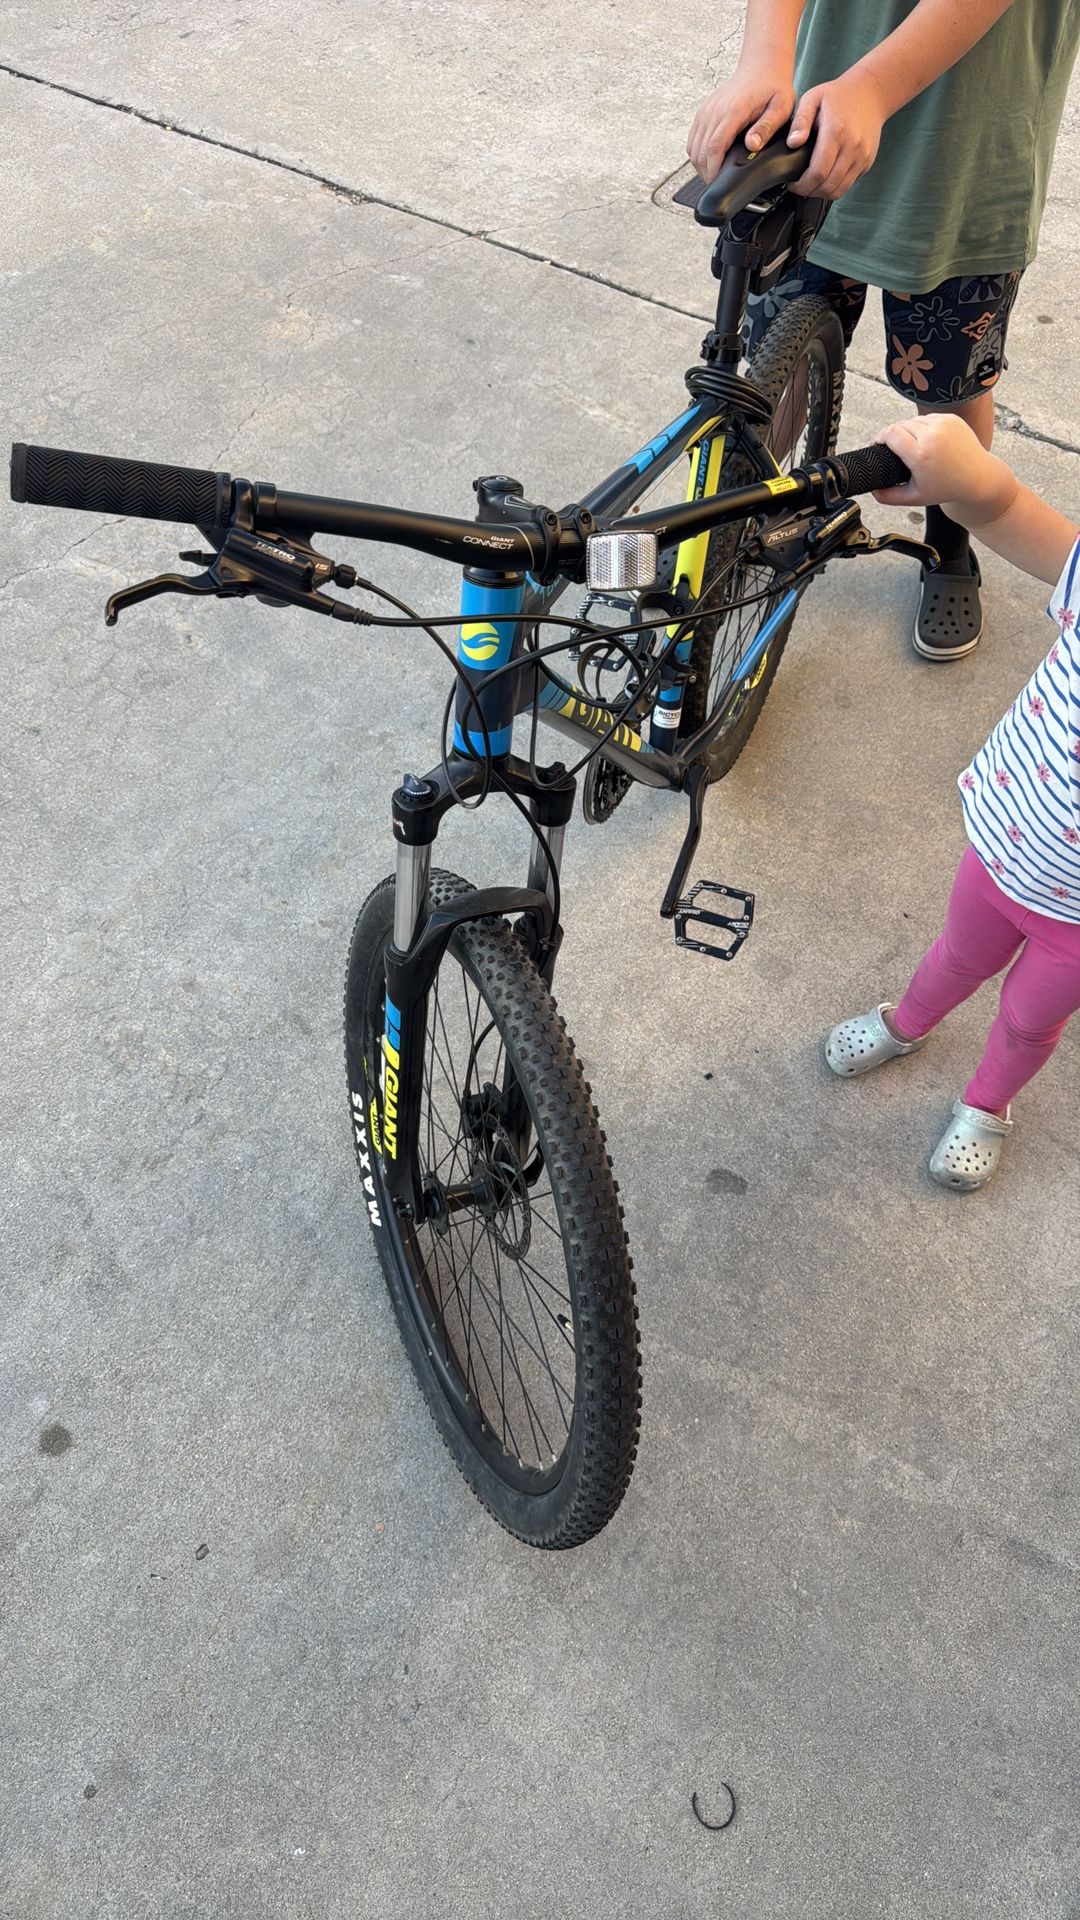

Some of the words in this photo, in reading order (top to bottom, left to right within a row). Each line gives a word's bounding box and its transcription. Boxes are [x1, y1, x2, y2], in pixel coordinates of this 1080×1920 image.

[698, 439, 710, 486] GIANT
[462, 535, 515, 550] CONNECT
[490, 535, 515, 543] GIANT
[767, 527, 799, 543] ALTUS
[384, 1065, 400, 1160] GIANT
[352, 1090, 382, 1227] MAXXIS
